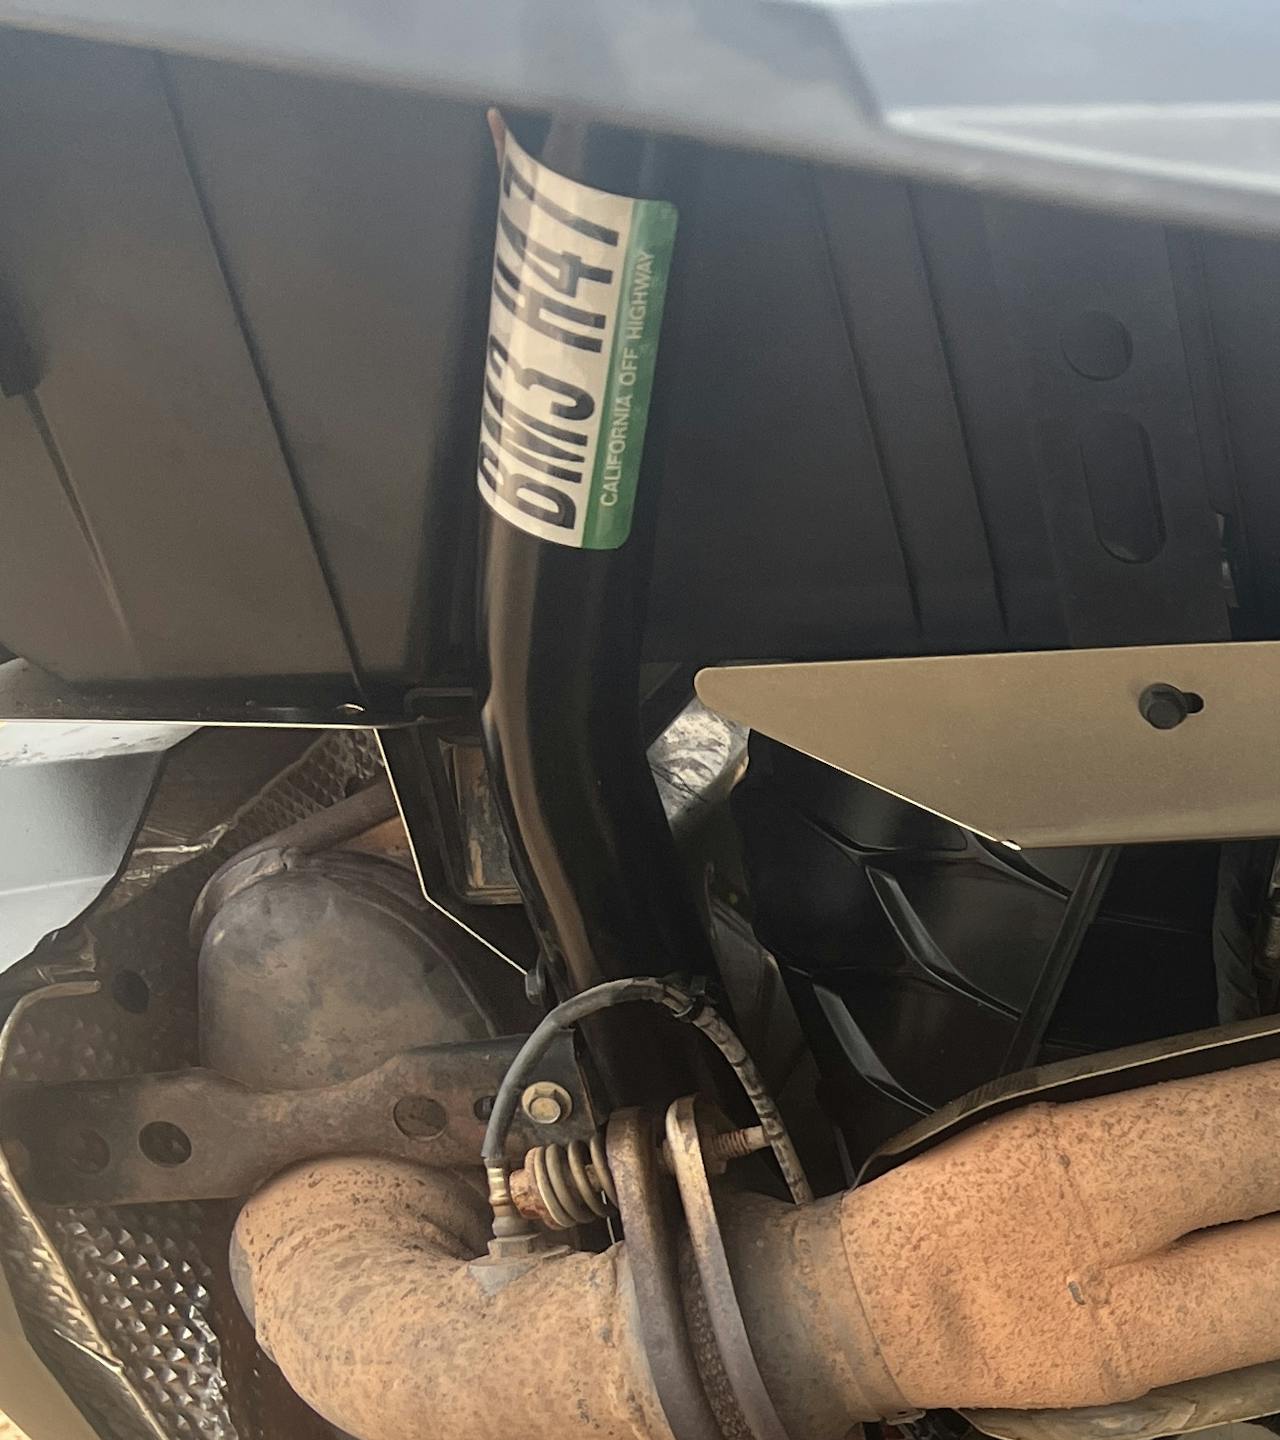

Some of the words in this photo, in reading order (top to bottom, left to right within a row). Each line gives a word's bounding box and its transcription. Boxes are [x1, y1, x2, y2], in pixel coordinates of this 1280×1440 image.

[625, 249, 656, 340] HIGHWAY
[619, 347, 640, 386] OFF
[479, 334, 595, 529] BM3
[600, 395, 634, 507] CALIFORNIA
